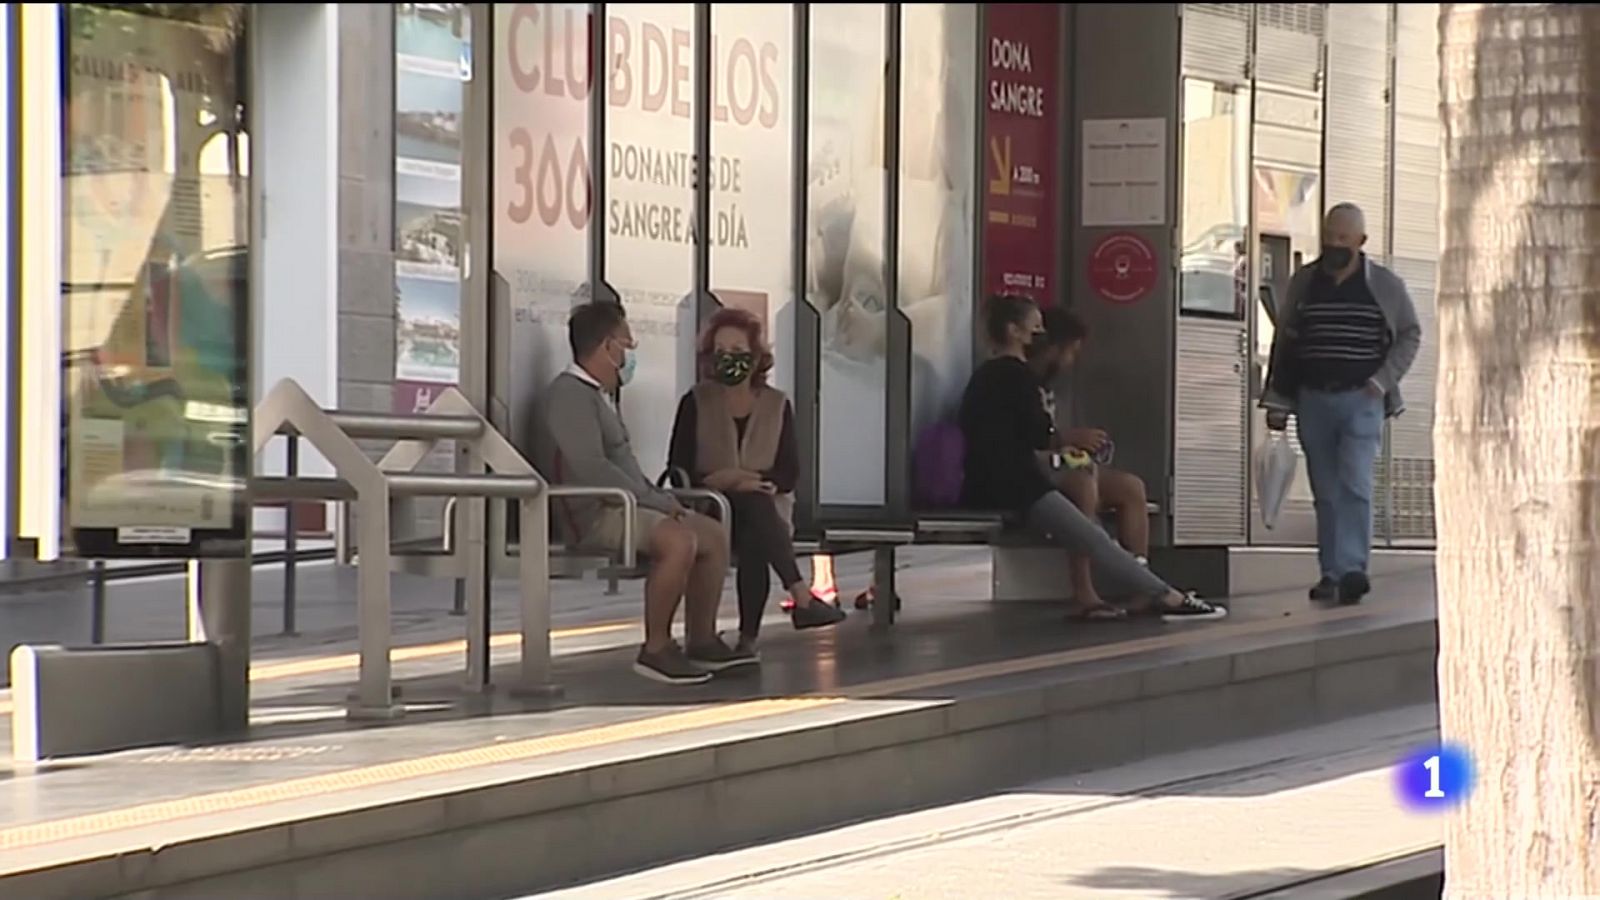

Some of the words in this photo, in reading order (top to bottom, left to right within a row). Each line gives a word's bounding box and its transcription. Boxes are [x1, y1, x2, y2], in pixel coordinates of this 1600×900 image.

[507, 3, 632, 108] CLUB
[641, 21, 691, 119] DE
[711, 34, 779, 130] LOS
[991, 37, 1031, 73] DONA
[990, 80, 1043, 117] SANGRE
[507, 126, 593, 231] 300
[720, 156, 742, 193] DE
[609, 199, 683, 243] SANGRE
[717, 203, 749, 249] DÍA
